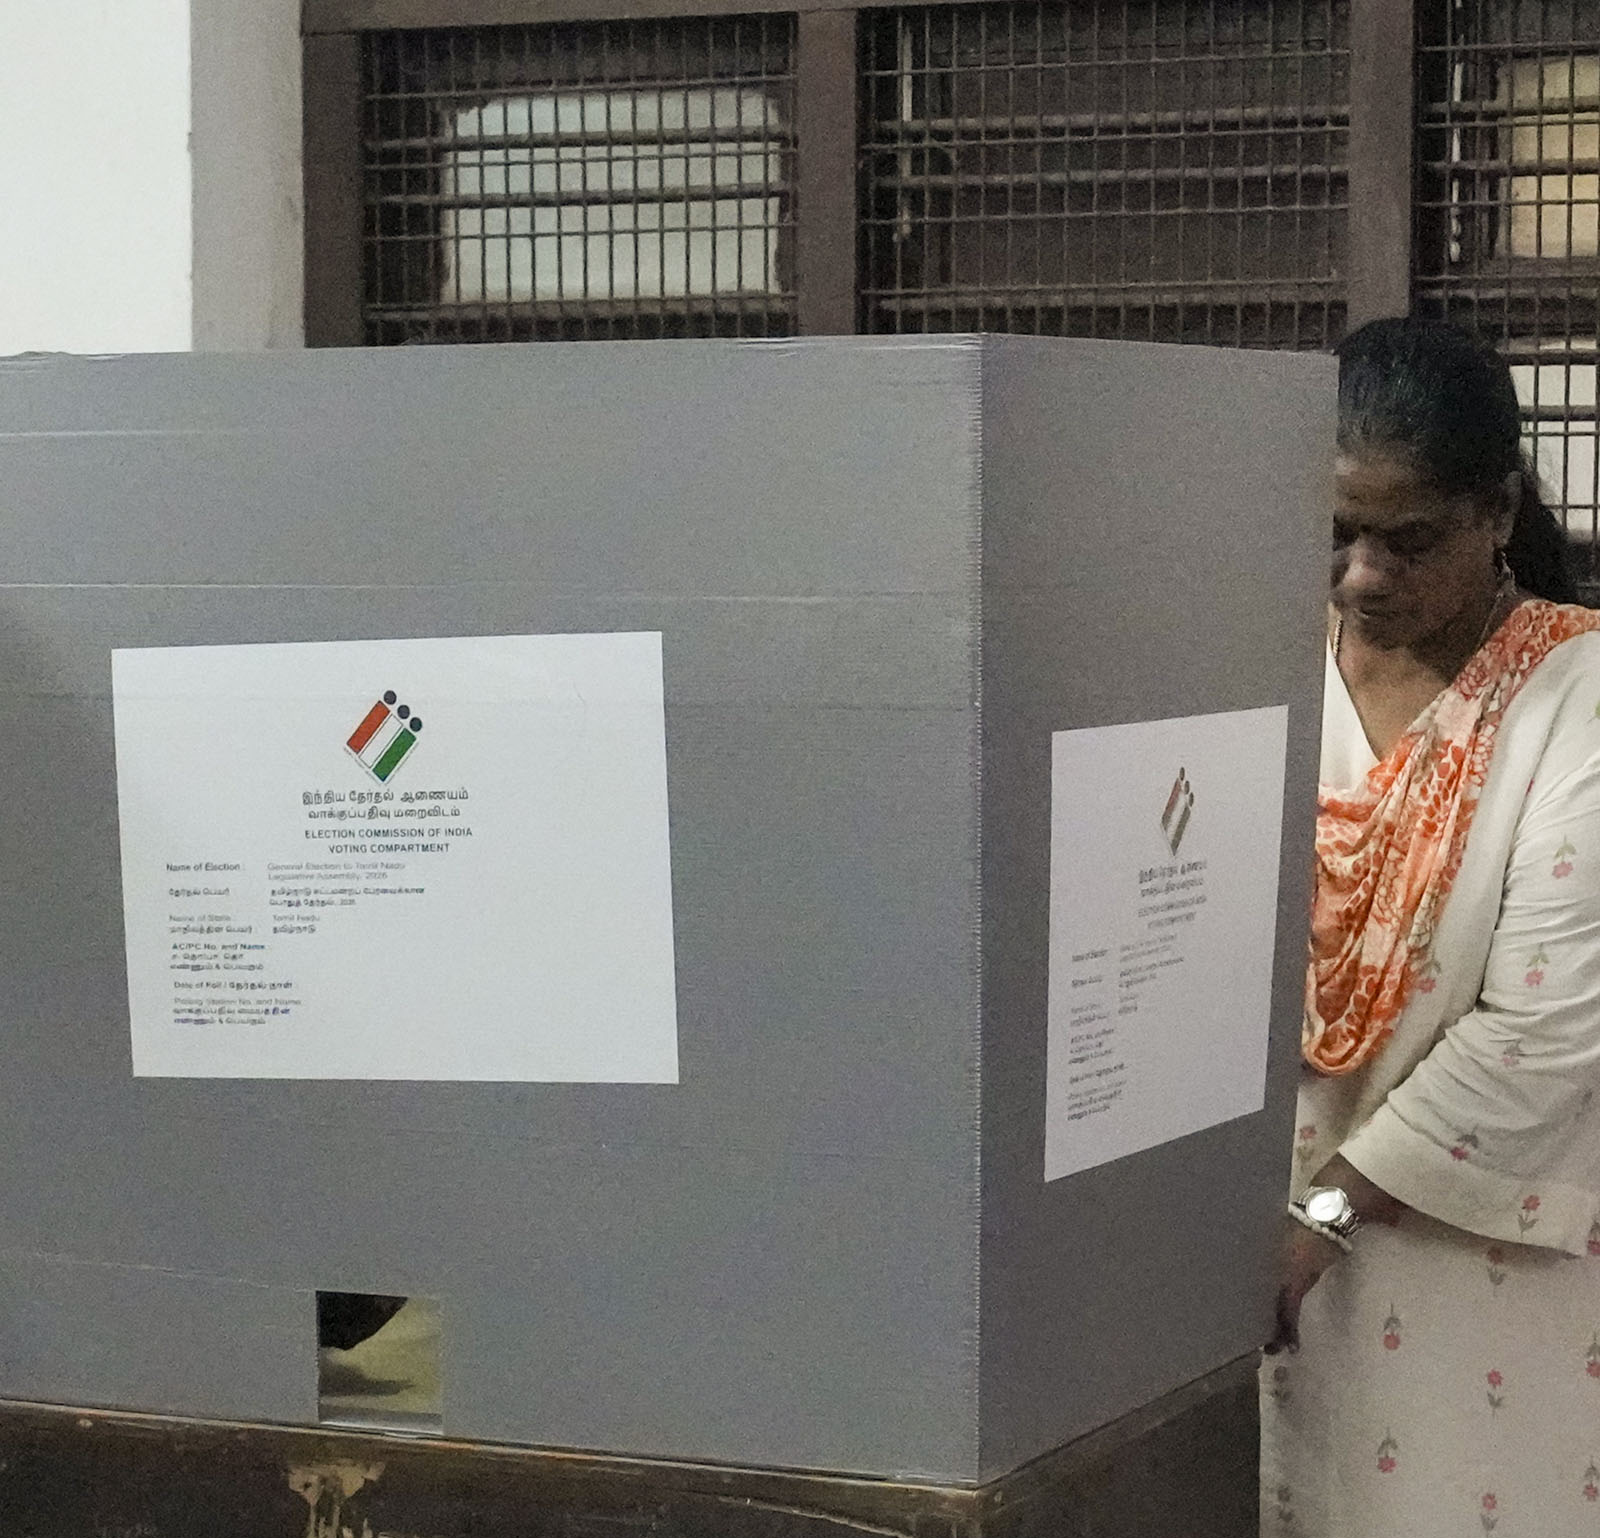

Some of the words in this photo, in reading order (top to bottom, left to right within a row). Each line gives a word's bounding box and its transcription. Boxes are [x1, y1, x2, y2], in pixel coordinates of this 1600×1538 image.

[302, 790, 345, 805] இந்திய
[350, 789, 394, 804] தேர்தல்
[400, 787, 468, 802] ஆணையம்
[308, 805, 390, 821] வாக்குப்பதிவு
[394, 805, 460, 819] மறைவிடம்
[305, 829, 355, 839] ELECTION
[358, 828, 424, 838] COMMISSION
[428, 828, 441, 837] OF
[445, 828, 472, 837] INDIA
[328, 844, 367, 854] VOTING
[370, 843, 449, 853] COMPARTMENT
[167, 863, 191, 871] Name
[193, 863, 202, 871] of
[205, 862, 240, 871] Election
